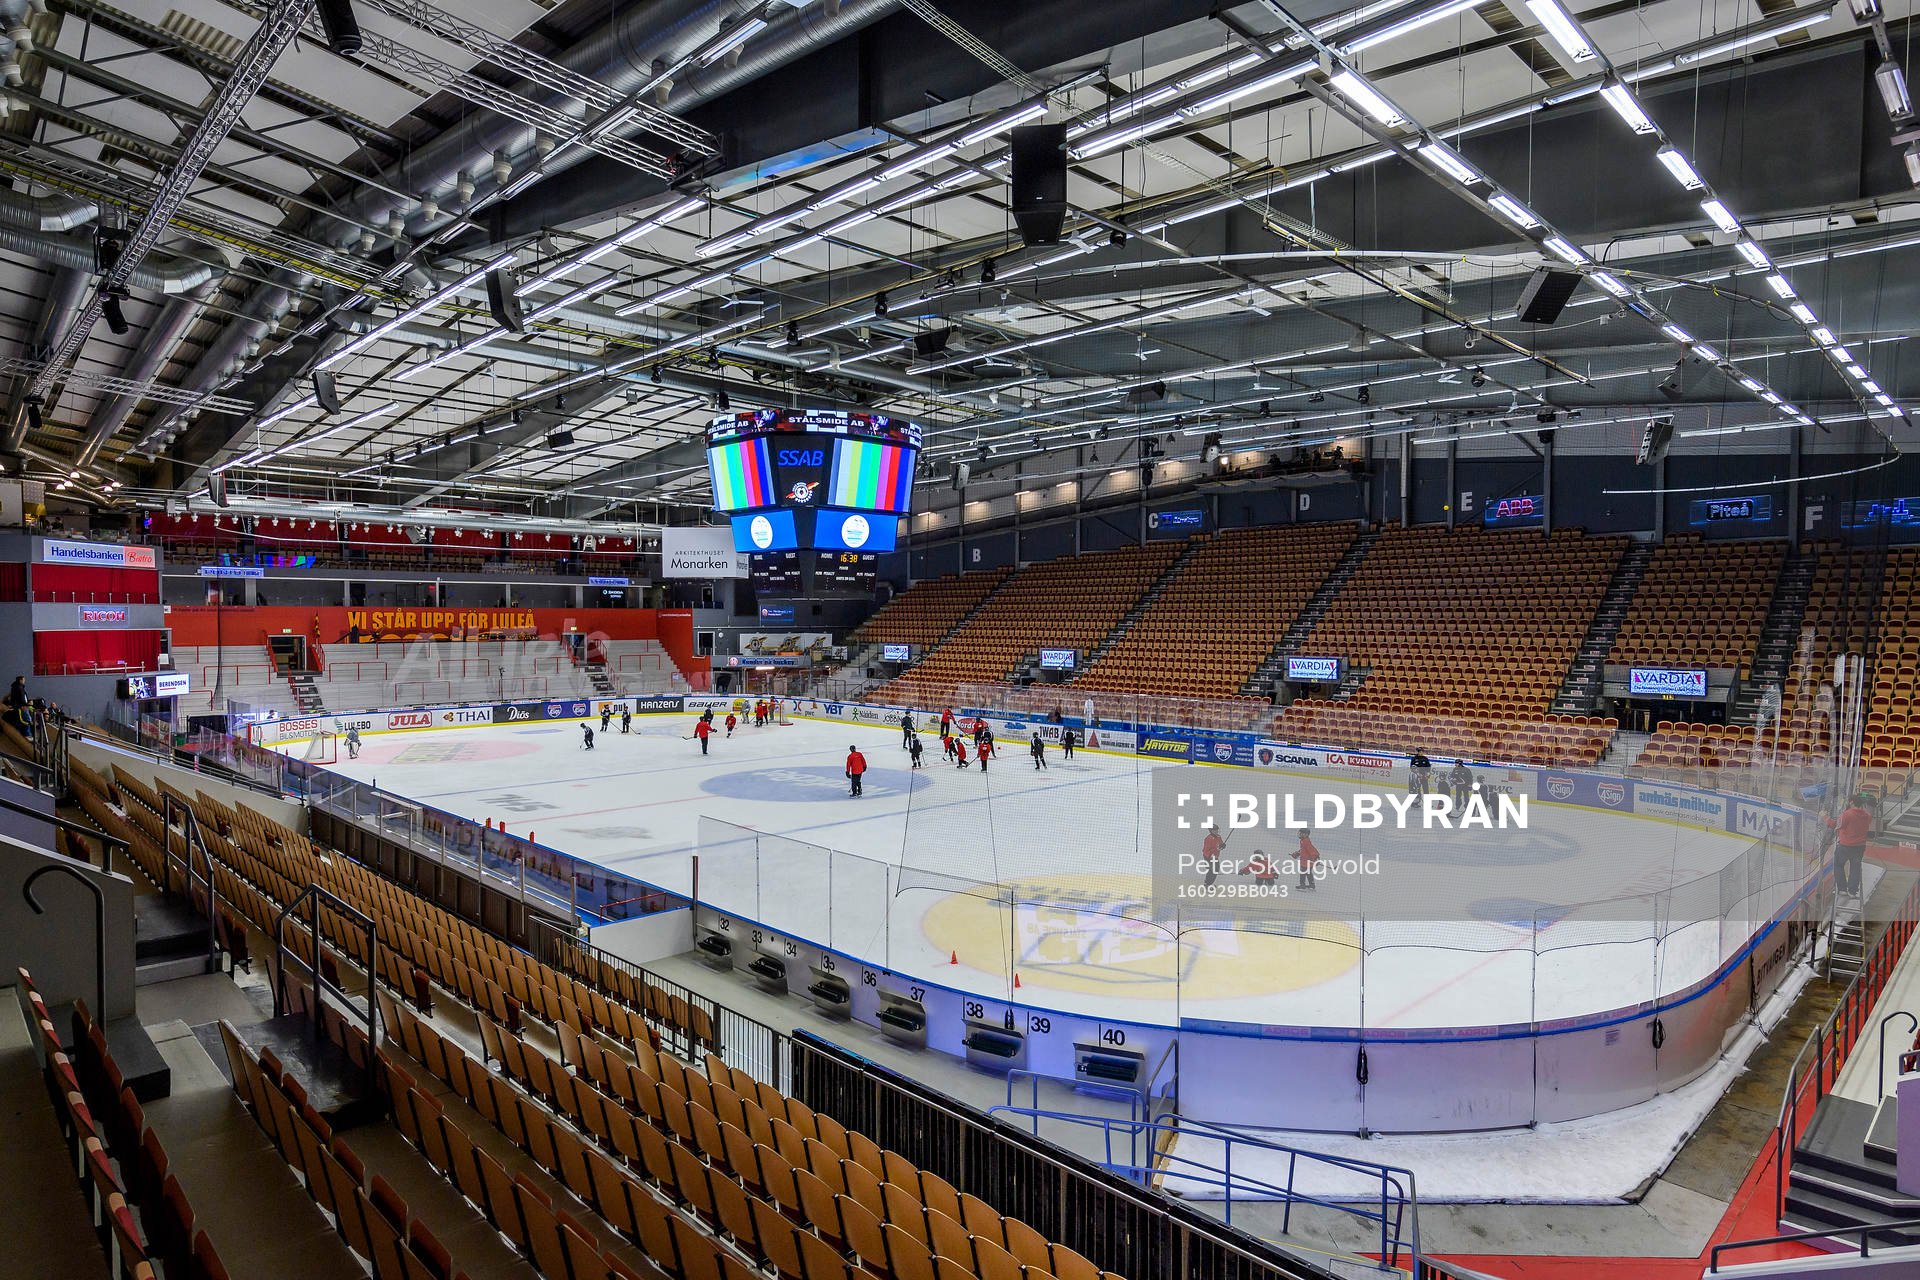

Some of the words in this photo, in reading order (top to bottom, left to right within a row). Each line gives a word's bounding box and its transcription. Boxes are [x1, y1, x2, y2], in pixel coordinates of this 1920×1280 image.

[737, 419, 749, 428] AB
[788, 415, 848, 425] STÅLSMIDE
[778, 449, 824, 467] SSAB
[1300, 494, 1310, 510] D
[1461, 492, 1472, 511] E
[1496, 499, 1534, 517] ABB
[1149, 513, 1158, 528] C
[1805, 506, 1823, 530] F
[51, 546, 124, 561] Handelsbanken
[840, 554, 858, 563] 16:38
[972, 548, 981, 562] B
[671, 556, 728, 569] Monarken
[83, 611, 125, 621] RICOH
[347, 611, 366, 630] VI
[372, 607, 417, 630] STÅR
[421, 611, 455, 629] UPP
[459, 609, 488, 629] FÖR
[492, 608, 535, 630] LULEÅ
[1295, 661, 1331, 670] VARDIA
[1640, 671, 1697, 684] VARDIA
[390, 713, 430, 726] JULA
[456, 710, 490, 722] THAI
[280, 719, 318, 732] BOSSES
[1139, 738, 1190, 753] HAVATOR
[1275, 754, 1318, 766] SCANIA
[1326, 753, 1345, 764] ICA
[1349, 756, 1391, 768] KVANTUM
[1370, 769, 1391, 777] 7-23
[1550, 783, 1571, 796] 4Sign
[1600, 789, 1621, 802] 4Sign
[720, 918, 730, 931] 32
[752, 930, 763, 944] 33
[786, 942, 797, 957] 34
[823, 955, 835, 970] 35
[864, 970, 877, 987] 36
[910, 986, 925, 1002] 37
[966, 1001, 984, 1019] 38
[1030, 1016, 1051, 1034] 39
[1103, 1028, 1126, 1046] 40
